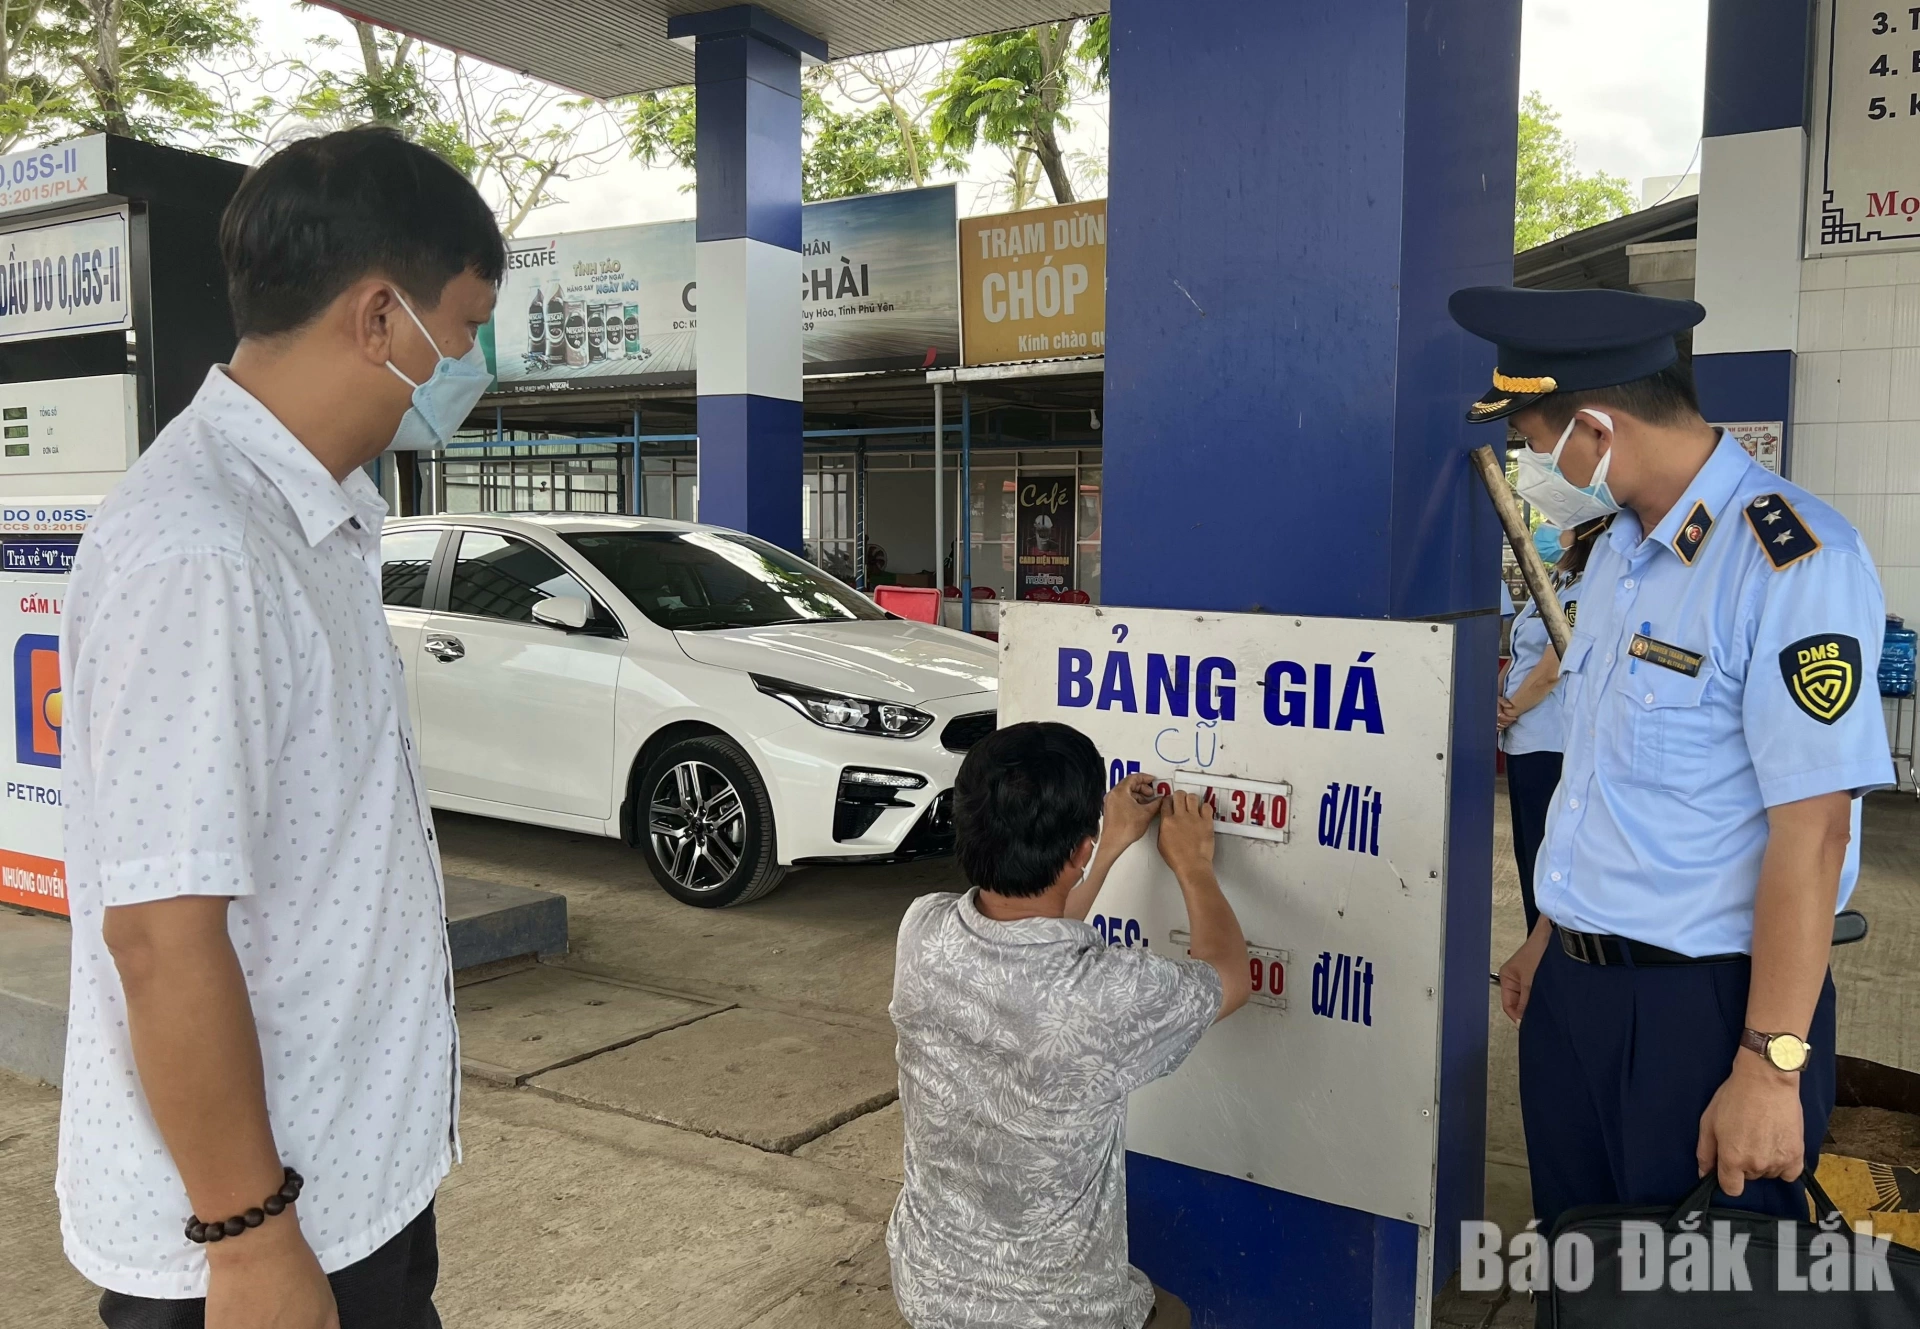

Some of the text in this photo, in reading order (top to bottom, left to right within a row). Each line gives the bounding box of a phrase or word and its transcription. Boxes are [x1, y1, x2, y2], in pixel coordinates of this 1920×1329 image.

[1872, 12, 1897, 35] 3.
[1869, 55, 1898, 77] 4.
[1868, 97, 1896, 120] 5.
[978, 211, 1105, 263] TRẠM DỪN
[505, 240, 557, 270] ESCAFÉ
[33, 258, 54, 312] DO
[58, 246, 120, 315] 0,05S-II
[584, 284, 594, 292] SAY
[982, 255, 1089, 323] CHÓP
[1018, 333, 1049, 352] Kính
[1053, 330, 1087, 349] chào
[1020, 482, 1068, 514] Café
[4, 510, 30, 521] DO
[33, 523, 88, 531] 03:2015/
[7, 548, 26, 566] Trả
[27, 547, 40, 566] về
[20, 593, 64, 614] CẤM L
[1797, 642, 1840, 665] DMS
[1056, 624, 1386, 735] BẢNG GIÁ
[1155, 720, 1219, 768] CŨ
[1318, 782, 1383, 857] đ/lít
[1311, 950, 1374, 1027] đ/lít
